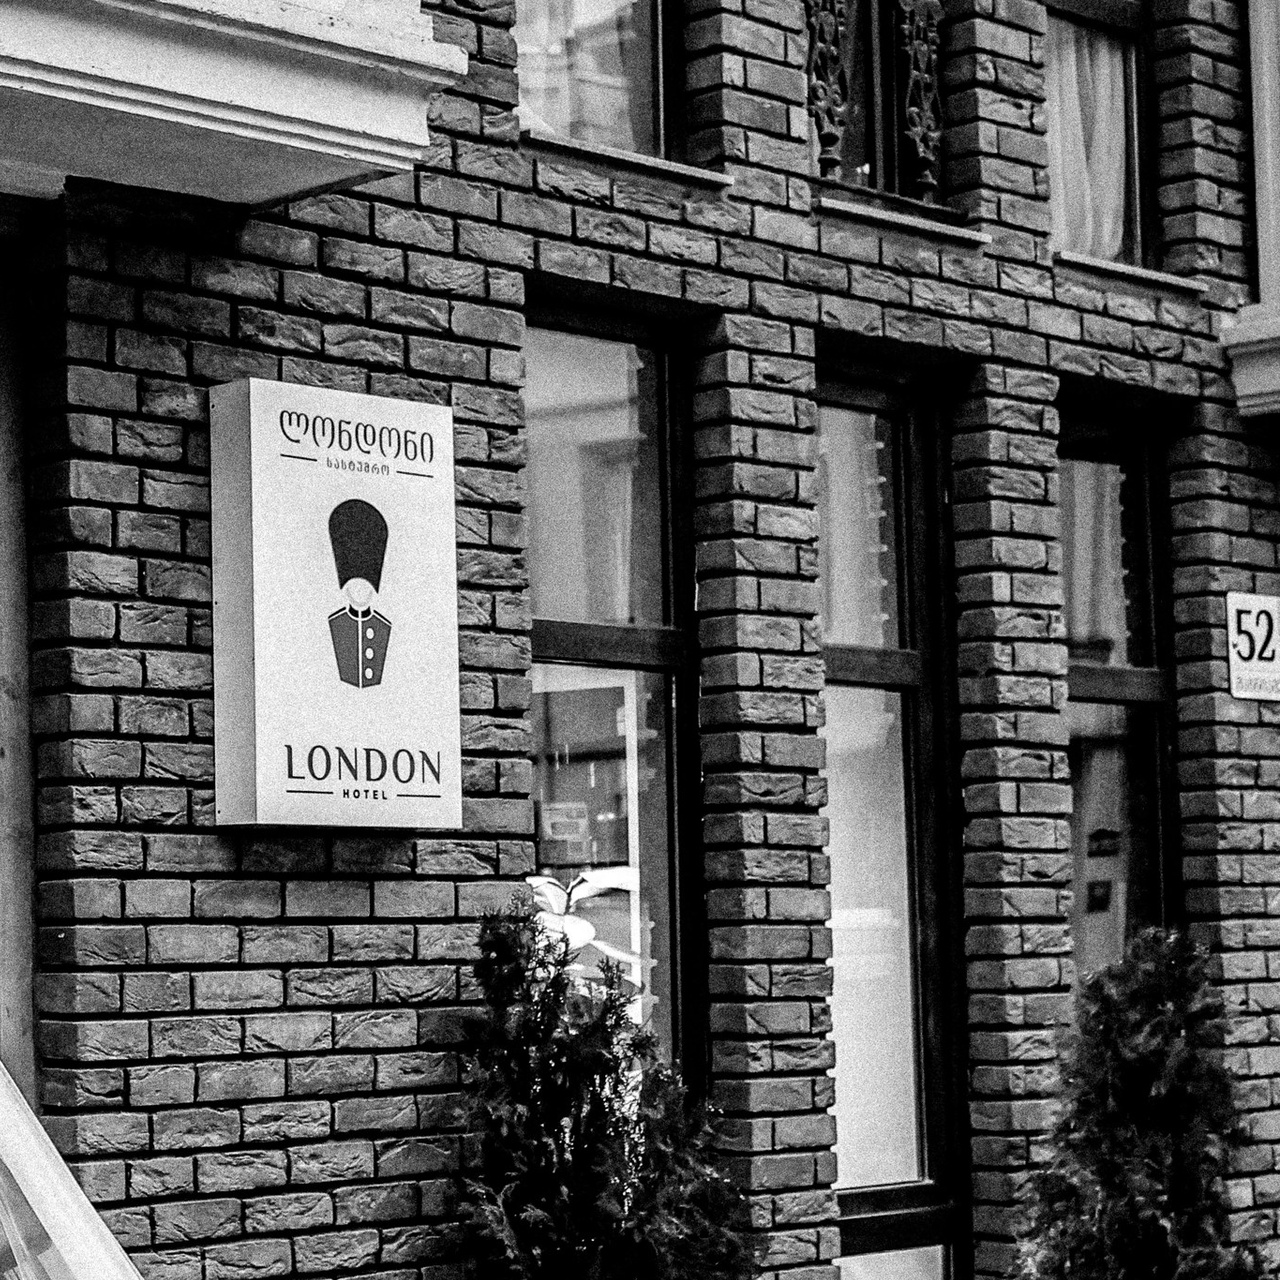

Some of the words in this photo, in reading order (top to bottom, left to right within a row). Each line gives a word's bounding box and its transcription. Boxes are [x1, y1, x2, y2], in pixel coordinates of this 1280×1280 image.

[279, 409, 434, 463] ლონდონი
[326, 456, 390, 476] სასტუმრო
[1235, 609, 1276, 661] 52
[284, 744, 441, 785] LONDON
[342, 788, 388, 801] HOTEL
